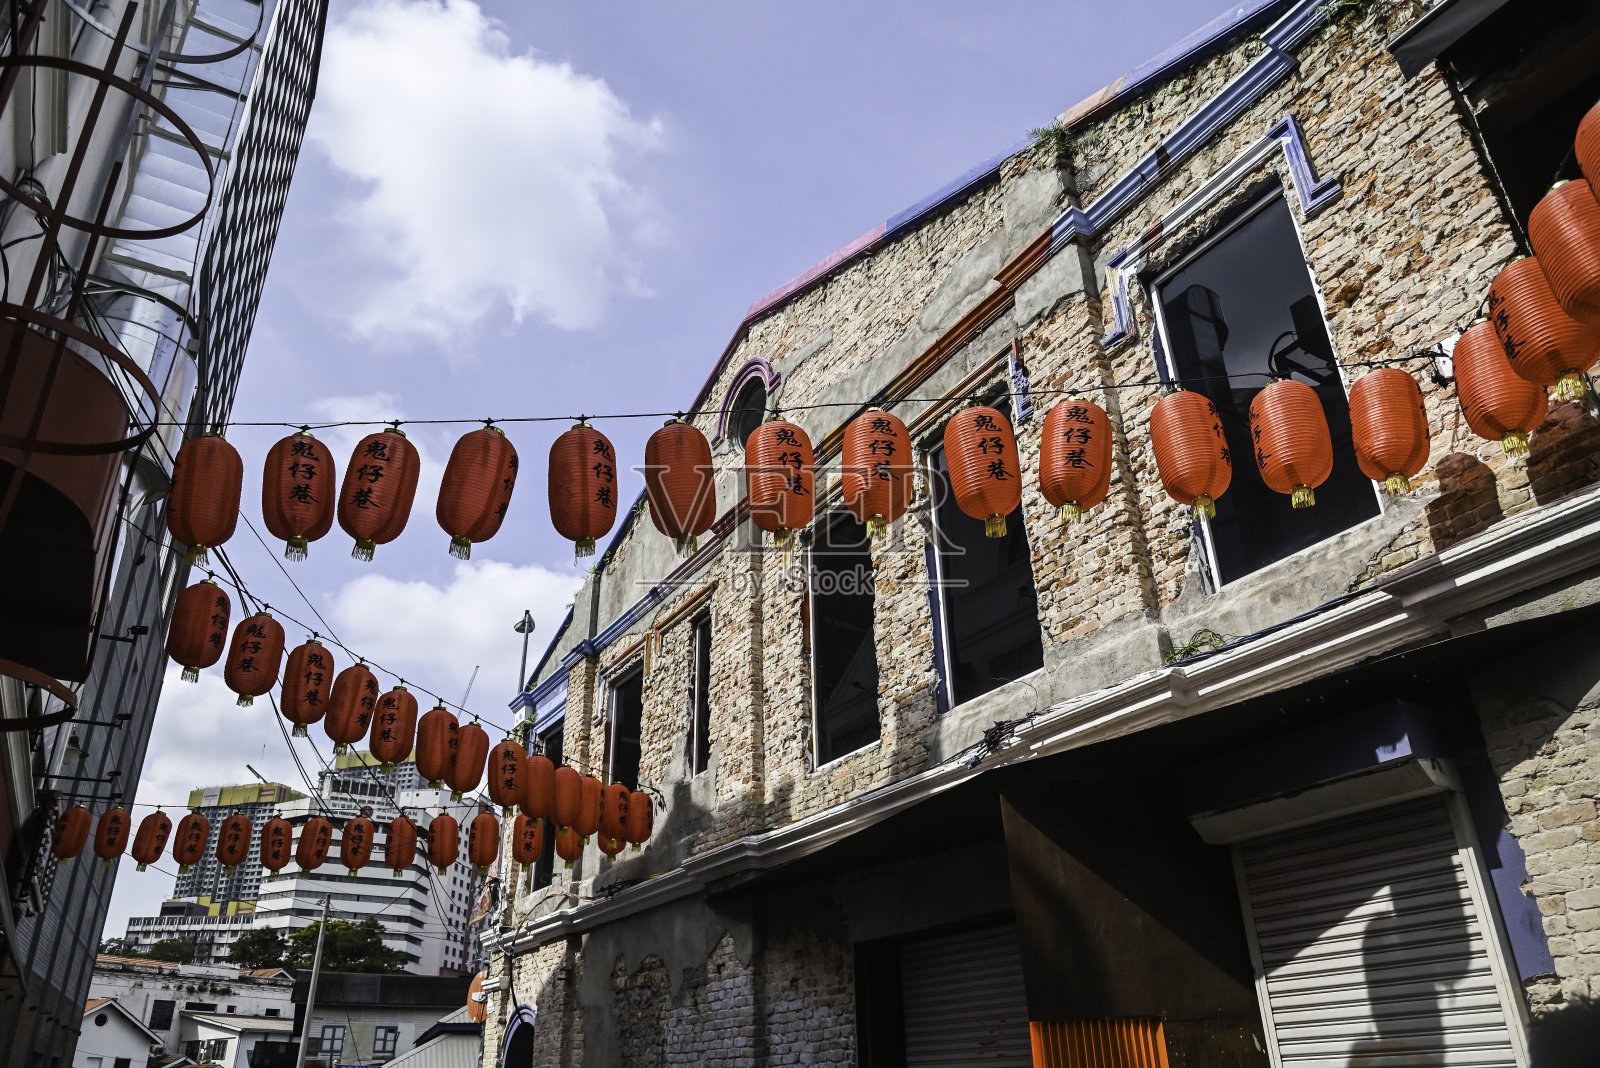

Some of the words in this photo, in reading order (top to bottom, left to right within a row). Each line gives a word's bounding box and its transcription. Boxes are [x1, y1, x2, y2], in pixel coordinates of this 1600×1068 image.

[776, 428, 809, 495] 鬼仔巷
[869, 417, 899, 480] 鬼仔巷
[974, 415, 1013, 480] 鬼仔巷
[1064, 406, 1094, 468] 鬼仔巷
[289, 440, 319, 504] 鬼仔巷
[350, 441, 390, 508] 鬼仔巷
[593, 439, 616, 509] 鬼仔巷
[209, 596, 230, 649] 鬼仔巷
[239, 623, 266, 672] 鬼仔巷
[304, 653, 326, 705] 鬼仔巷
[380, 697, 399, 742] 鬼仔巷
[502, 750, 518, 790] 鬼仔巷
